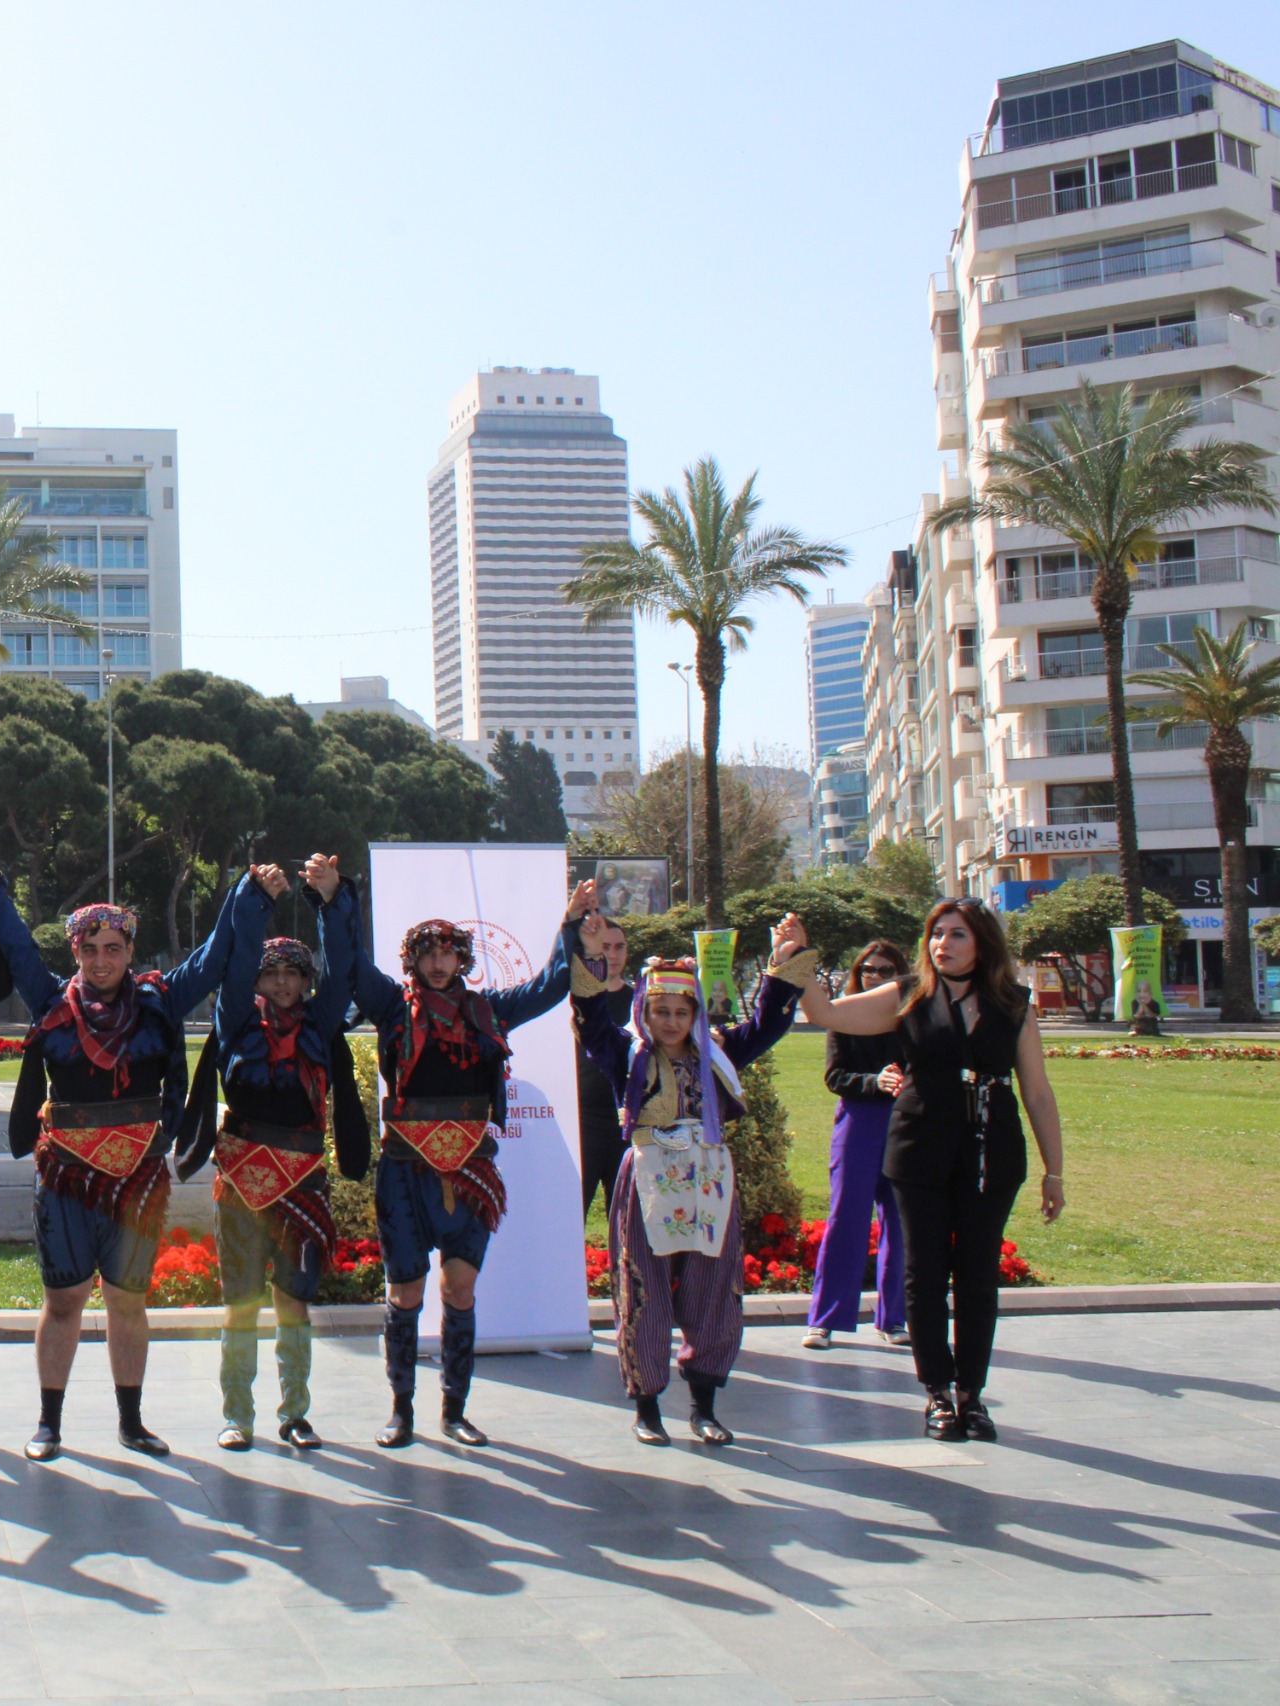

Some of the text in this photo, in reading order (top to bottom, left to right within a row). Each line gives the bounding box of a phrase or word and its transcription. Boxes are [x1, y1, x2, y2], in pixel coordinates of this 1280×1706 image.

[1034, 827, 1097, 842] RENGİN
[1040, 840, 1091, 849] HUKUK
[507, 1085, 518, 1100] Ğİ
[505, 1106, 555, 1119] ZMETLER
